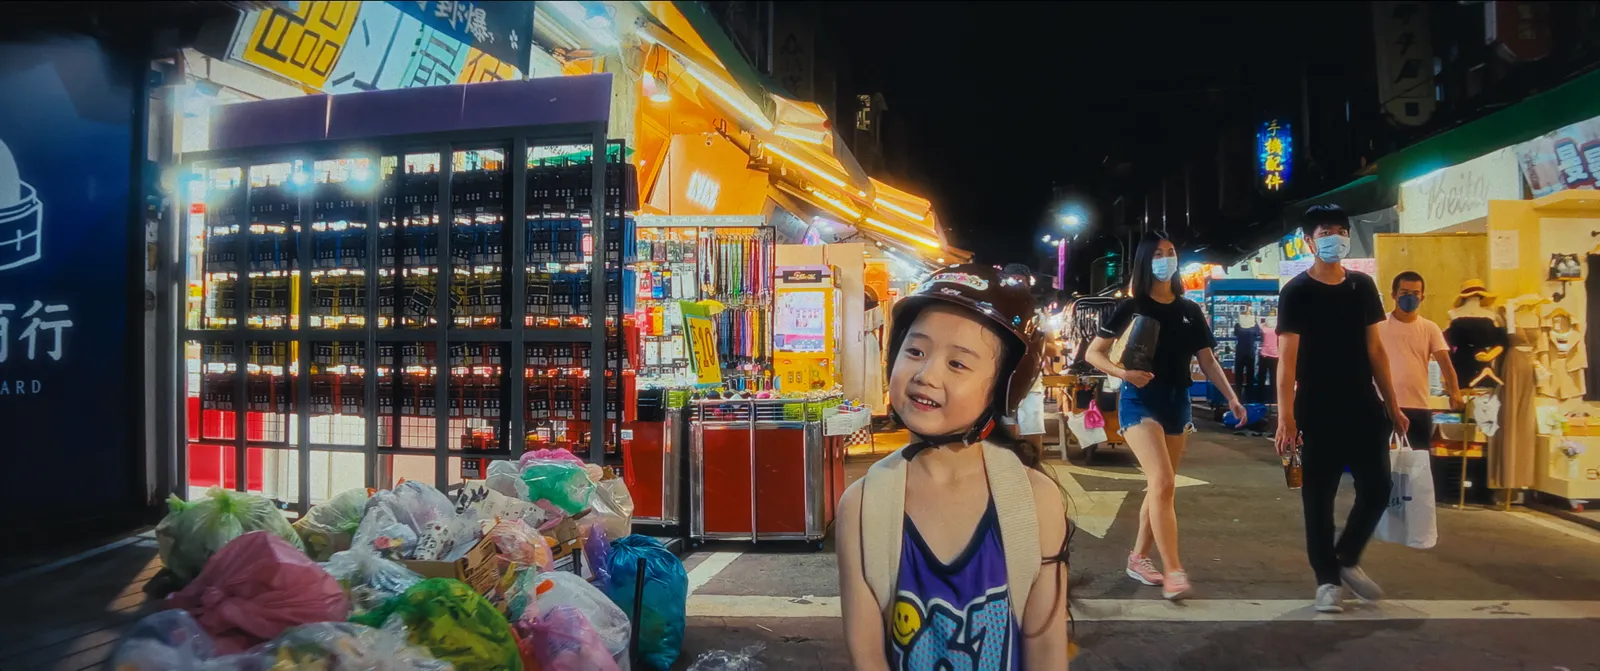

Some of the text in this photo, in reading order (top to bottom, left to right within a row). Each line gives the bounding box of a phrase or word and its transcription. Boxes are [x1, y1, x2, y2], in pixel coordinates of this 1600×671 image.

[418, 1, 496, 43] 到爆
[1263, 119, 1284, 191] 手機配件
[0, 299, 73, 363] 行
